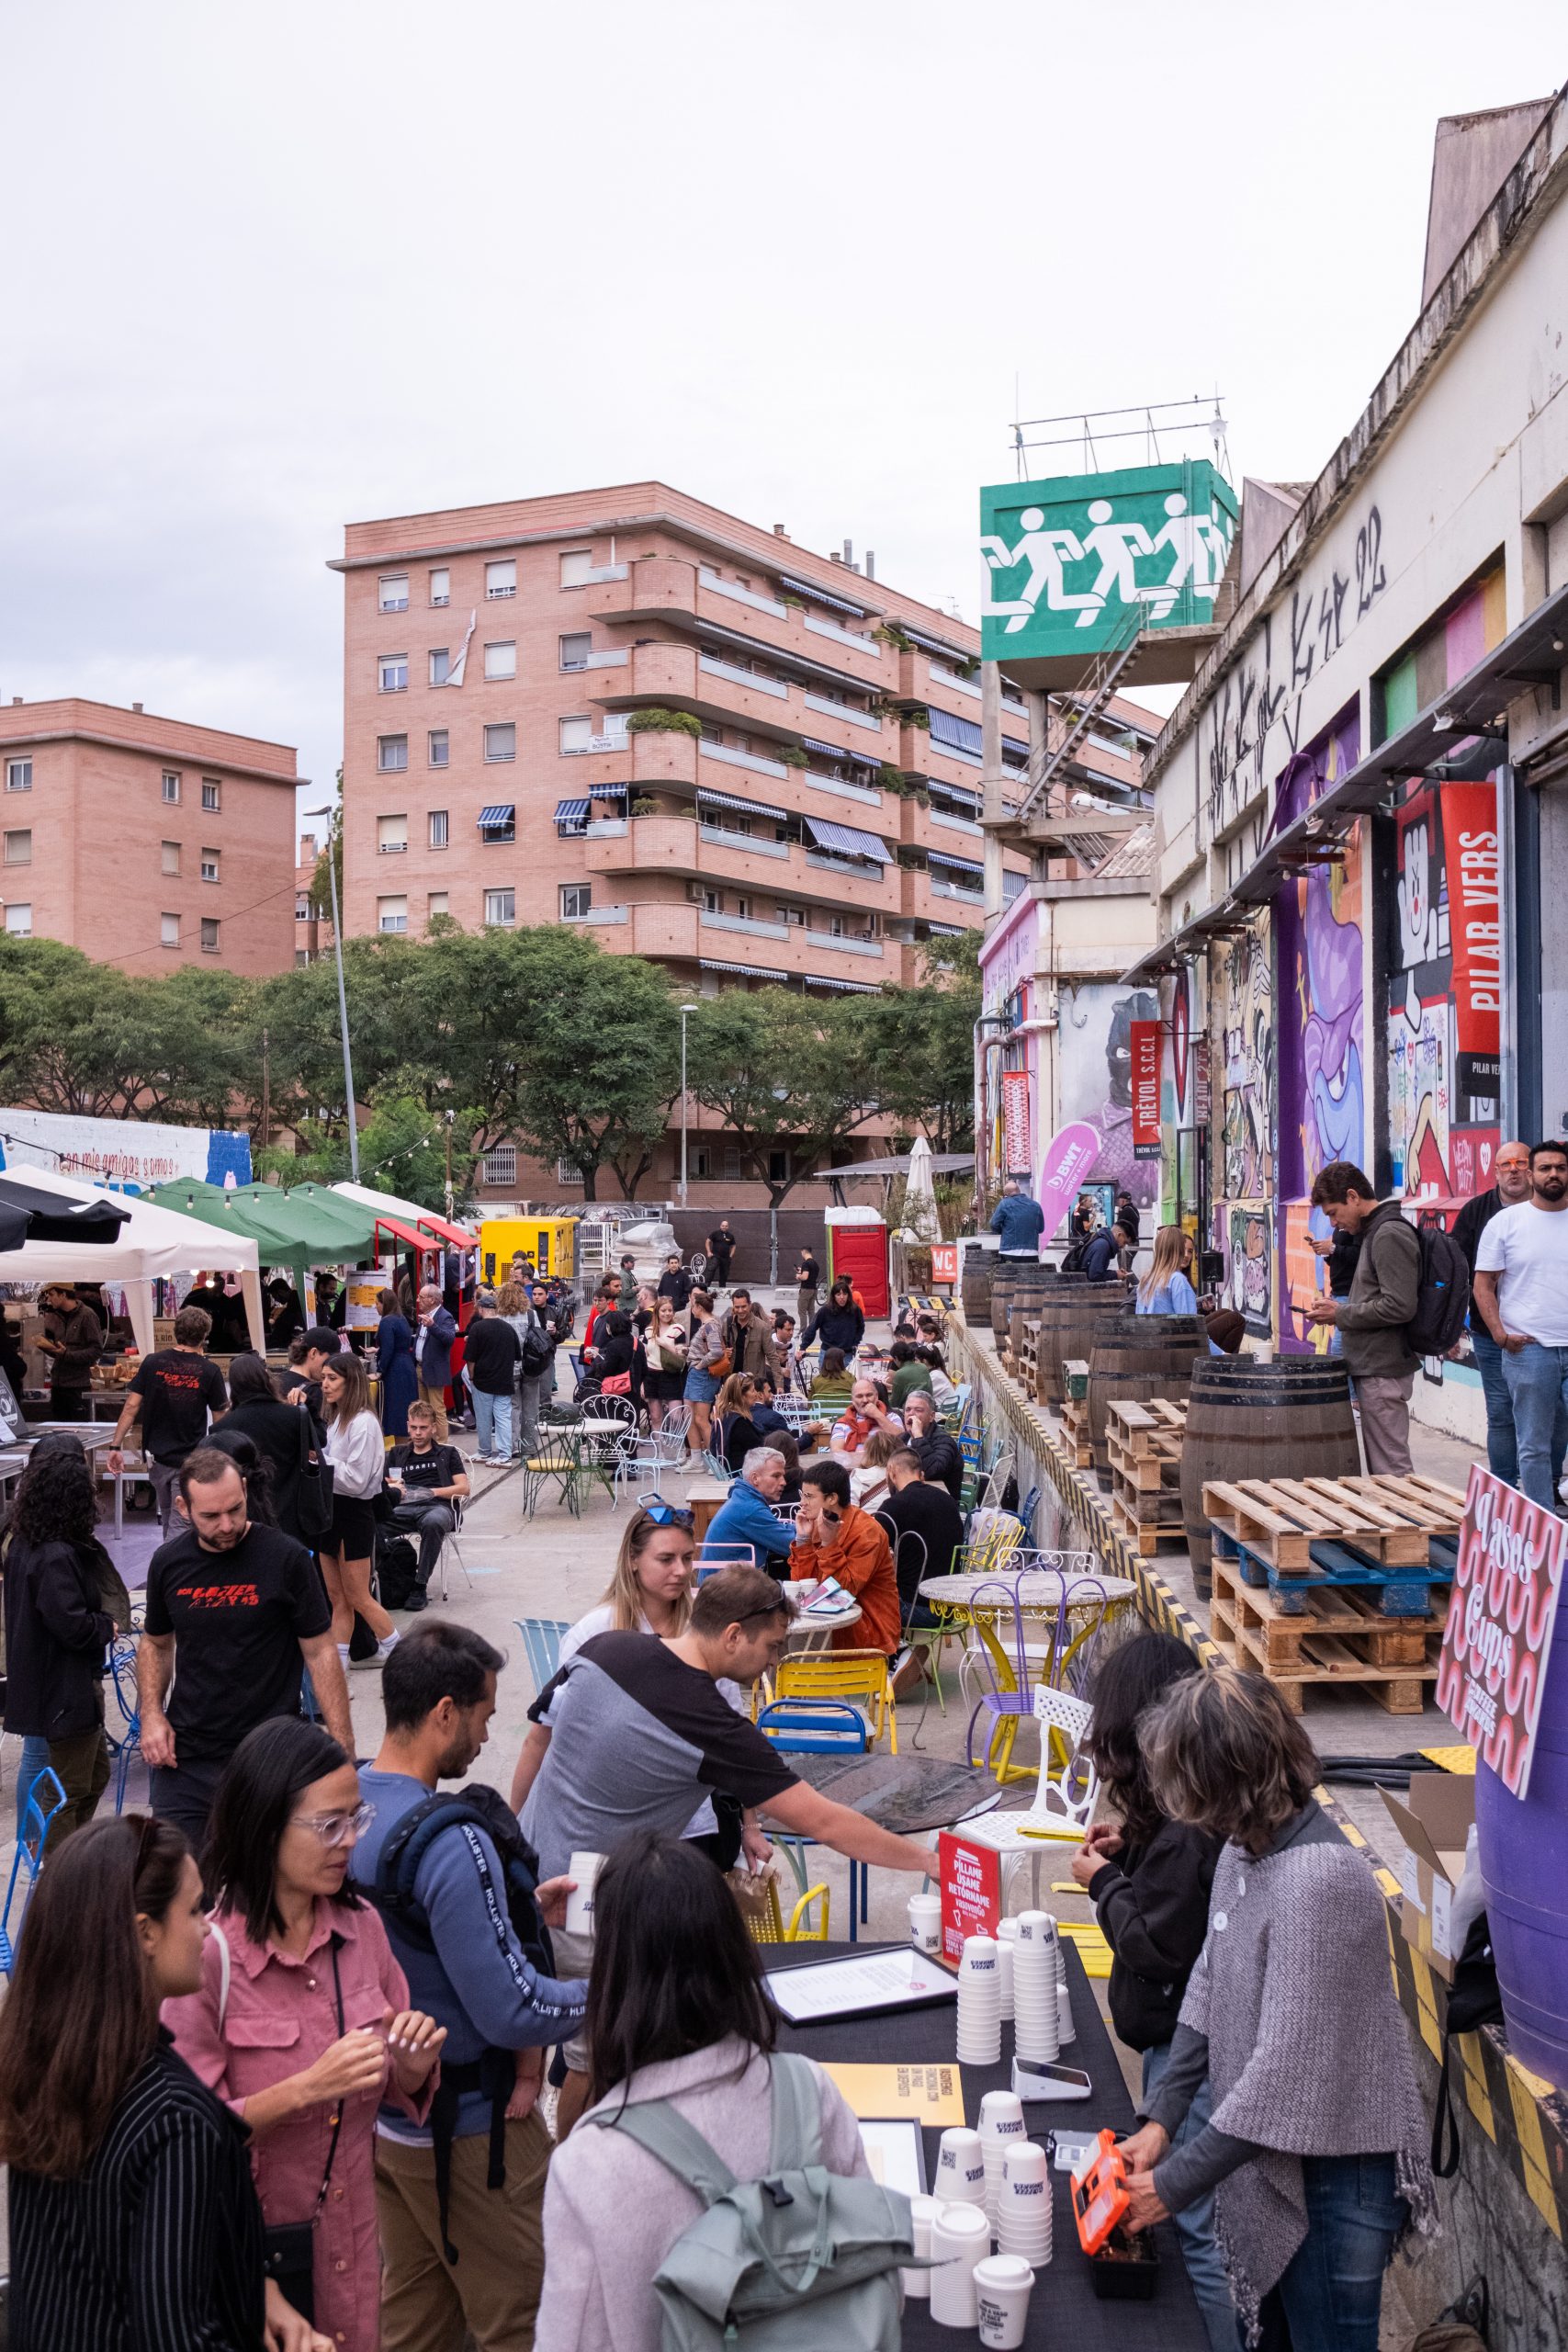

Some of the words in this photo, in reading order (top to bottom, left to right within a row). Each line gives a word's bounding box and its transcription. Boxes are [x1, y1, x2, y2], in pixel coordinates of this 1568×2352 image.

[1459, 831, 1499, 908] VERS
[1466, 922, 1500, 1011] PILAR
[1472, 1062, 1490, 1074] PILAR
[1135, 1077, 1157, 1128] TRÈVOL
[1056, 1141, 1082, 1177] BWT
[1064, 1173, 1080, 1196] water
[1078, 1149, 1092, 1169] more
[932, 1250, 953, 1271] WC
[1465, 1583, 1513, 1679] Cups
[1470, 1678, 1498, 1720] COFFEE
[461, 1824, 487, 1873] HOLLISTER
